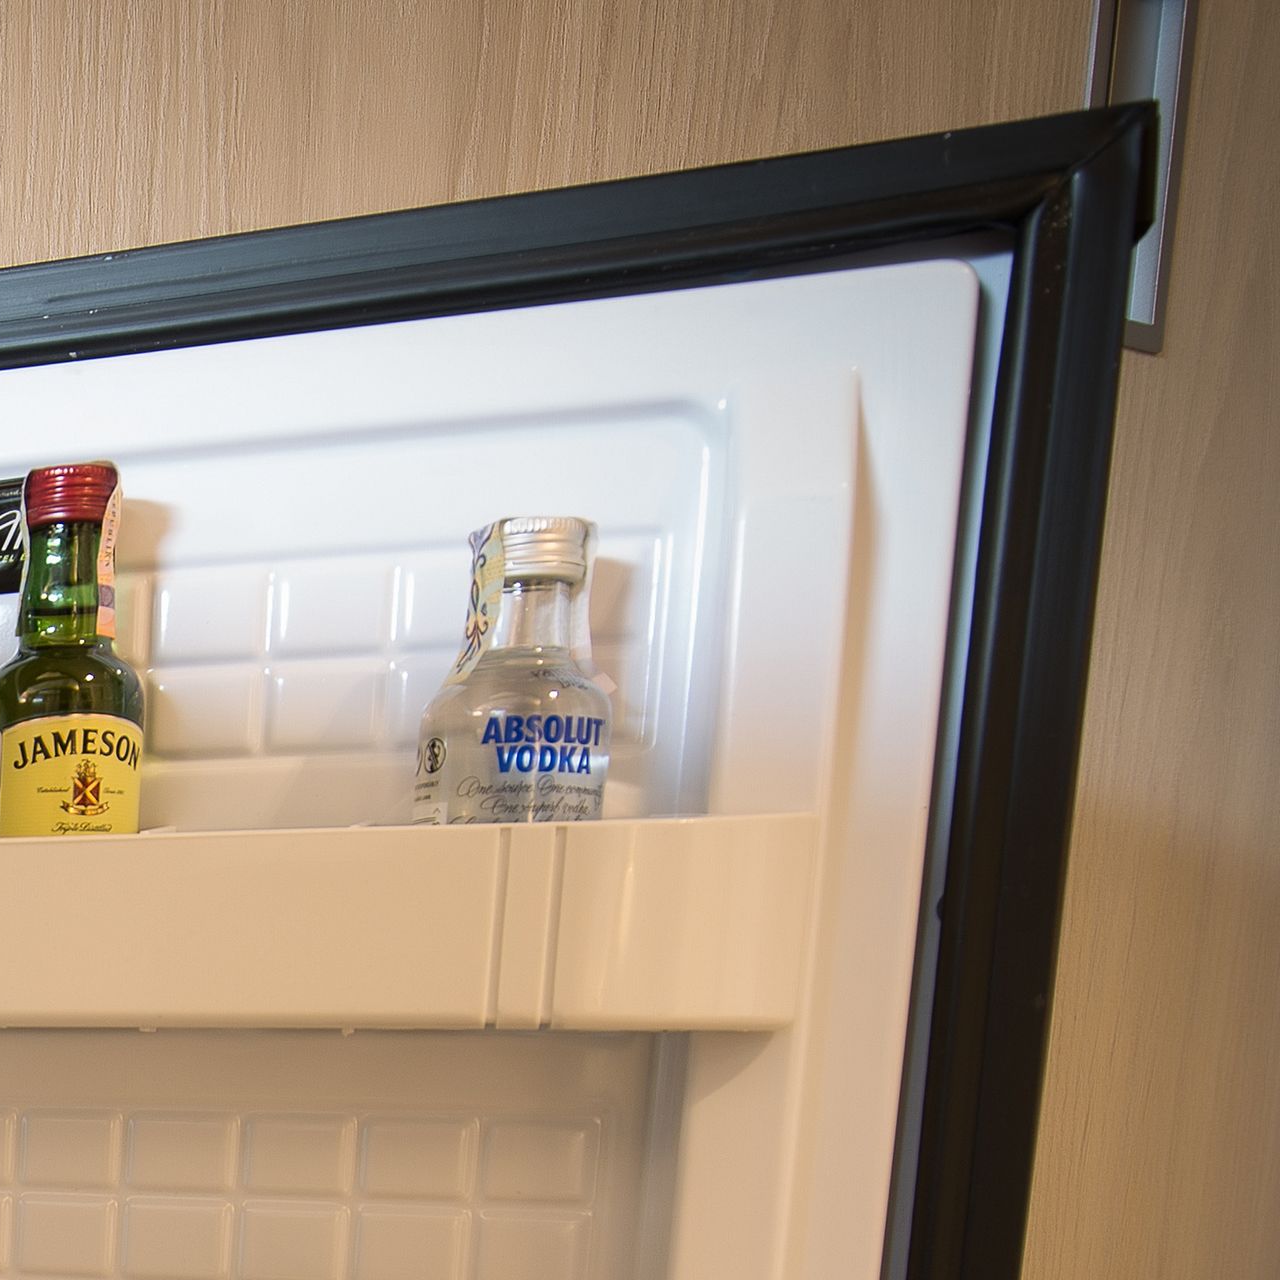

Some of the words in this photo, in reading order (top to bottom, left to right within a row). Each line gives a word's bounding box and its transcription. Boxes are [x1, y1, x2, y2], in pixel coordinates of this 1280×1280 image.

[481, 714, 605, 746] ABSOLUT
[13, 729, 140, 771] JAMESON
[496, 745, 591, 775] VODKA
